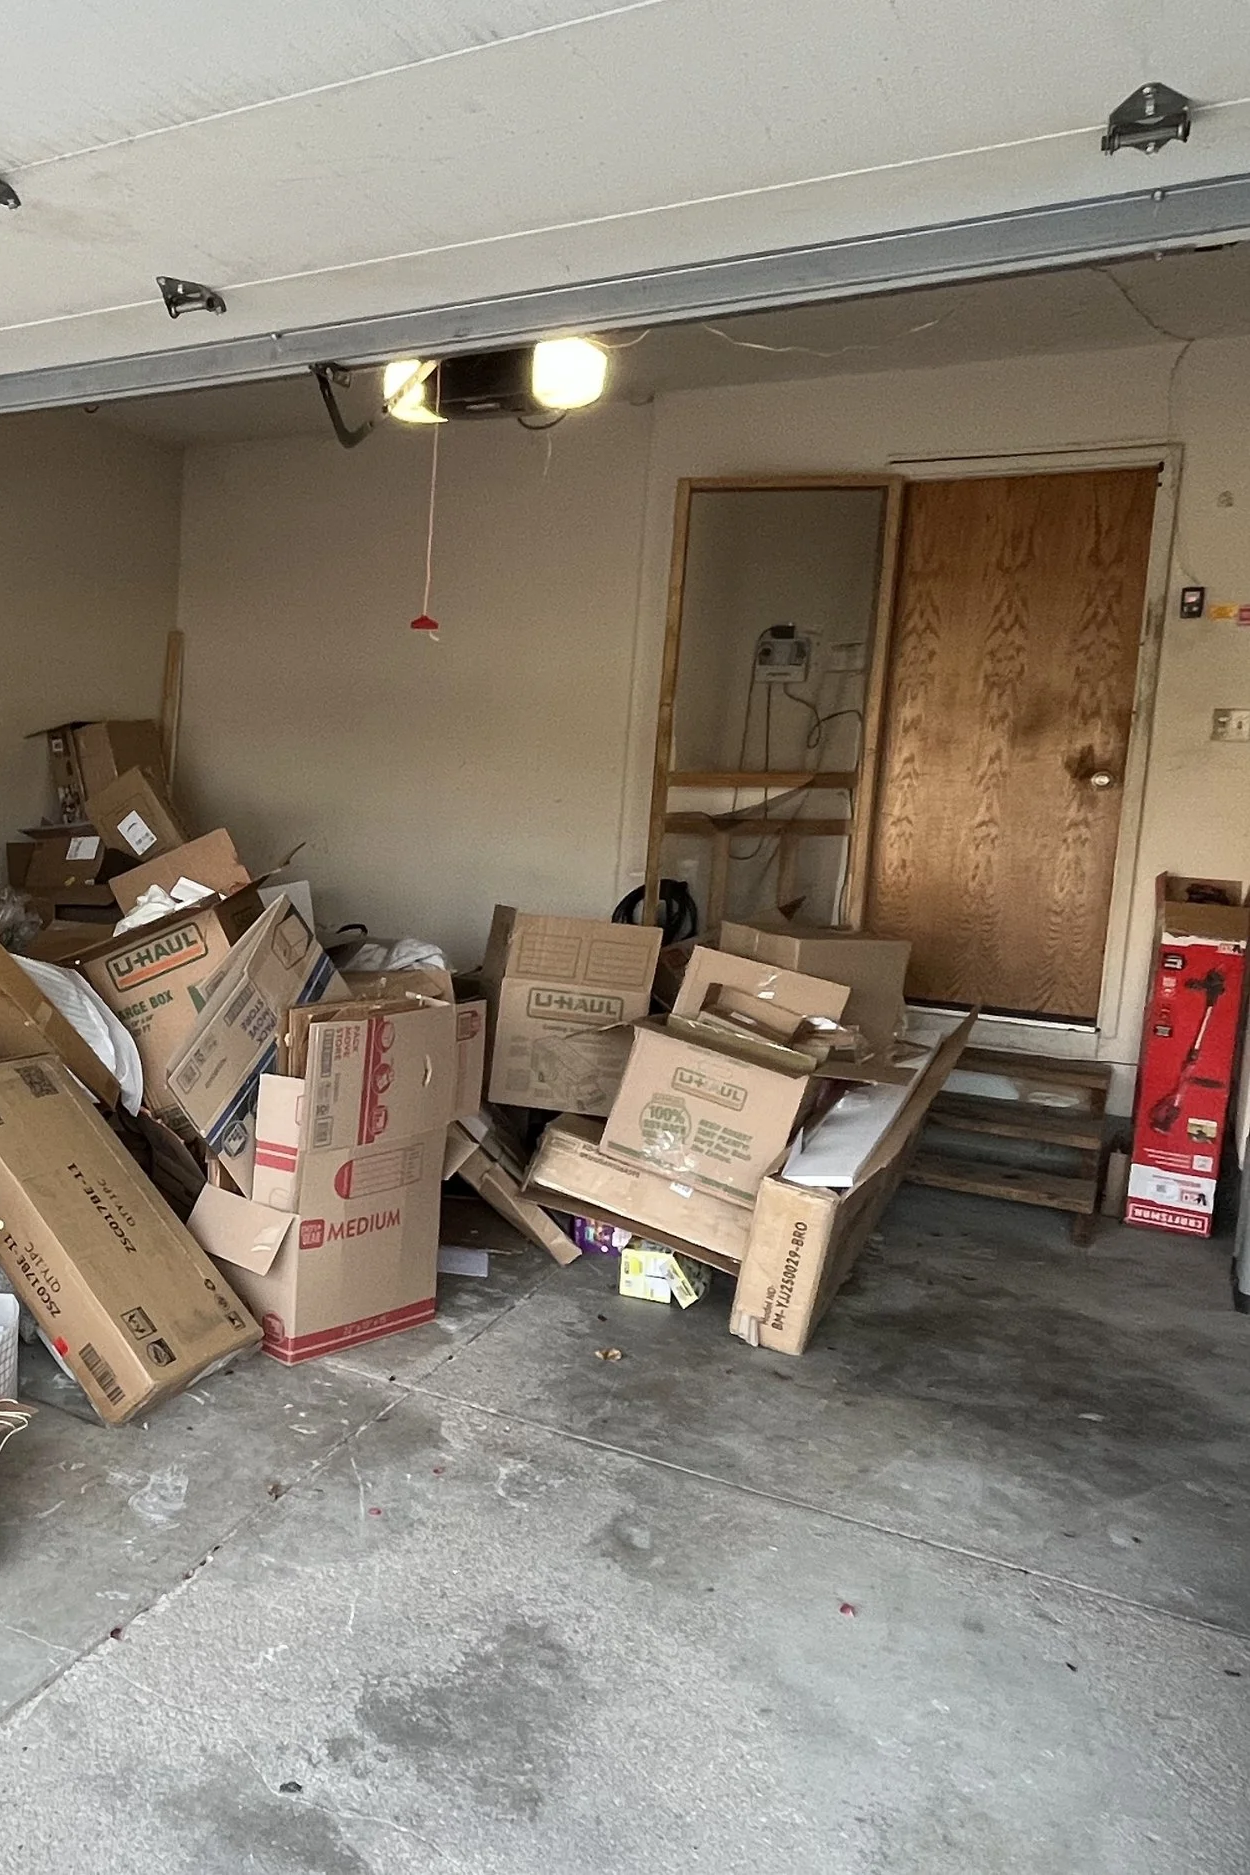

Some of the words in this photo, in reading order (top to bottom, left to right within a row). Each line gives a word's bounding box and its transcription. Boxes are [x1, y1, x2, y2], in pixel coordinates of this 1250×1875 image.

[113, 931, 198, 977] U-HAUL
[117, 1001, 148, 1020] ARGE
[149, 990, 174, 1009] BOX
[240, 998, 264, 1032] STORE
[535, 993, 618, 1016] U-HAUL
[649, 1105, 687, 1124] 100%
[327, 1208, 401, 1241] MEDIUM
[1133, 1208, 1203, 1229] CRAFTSMAN
